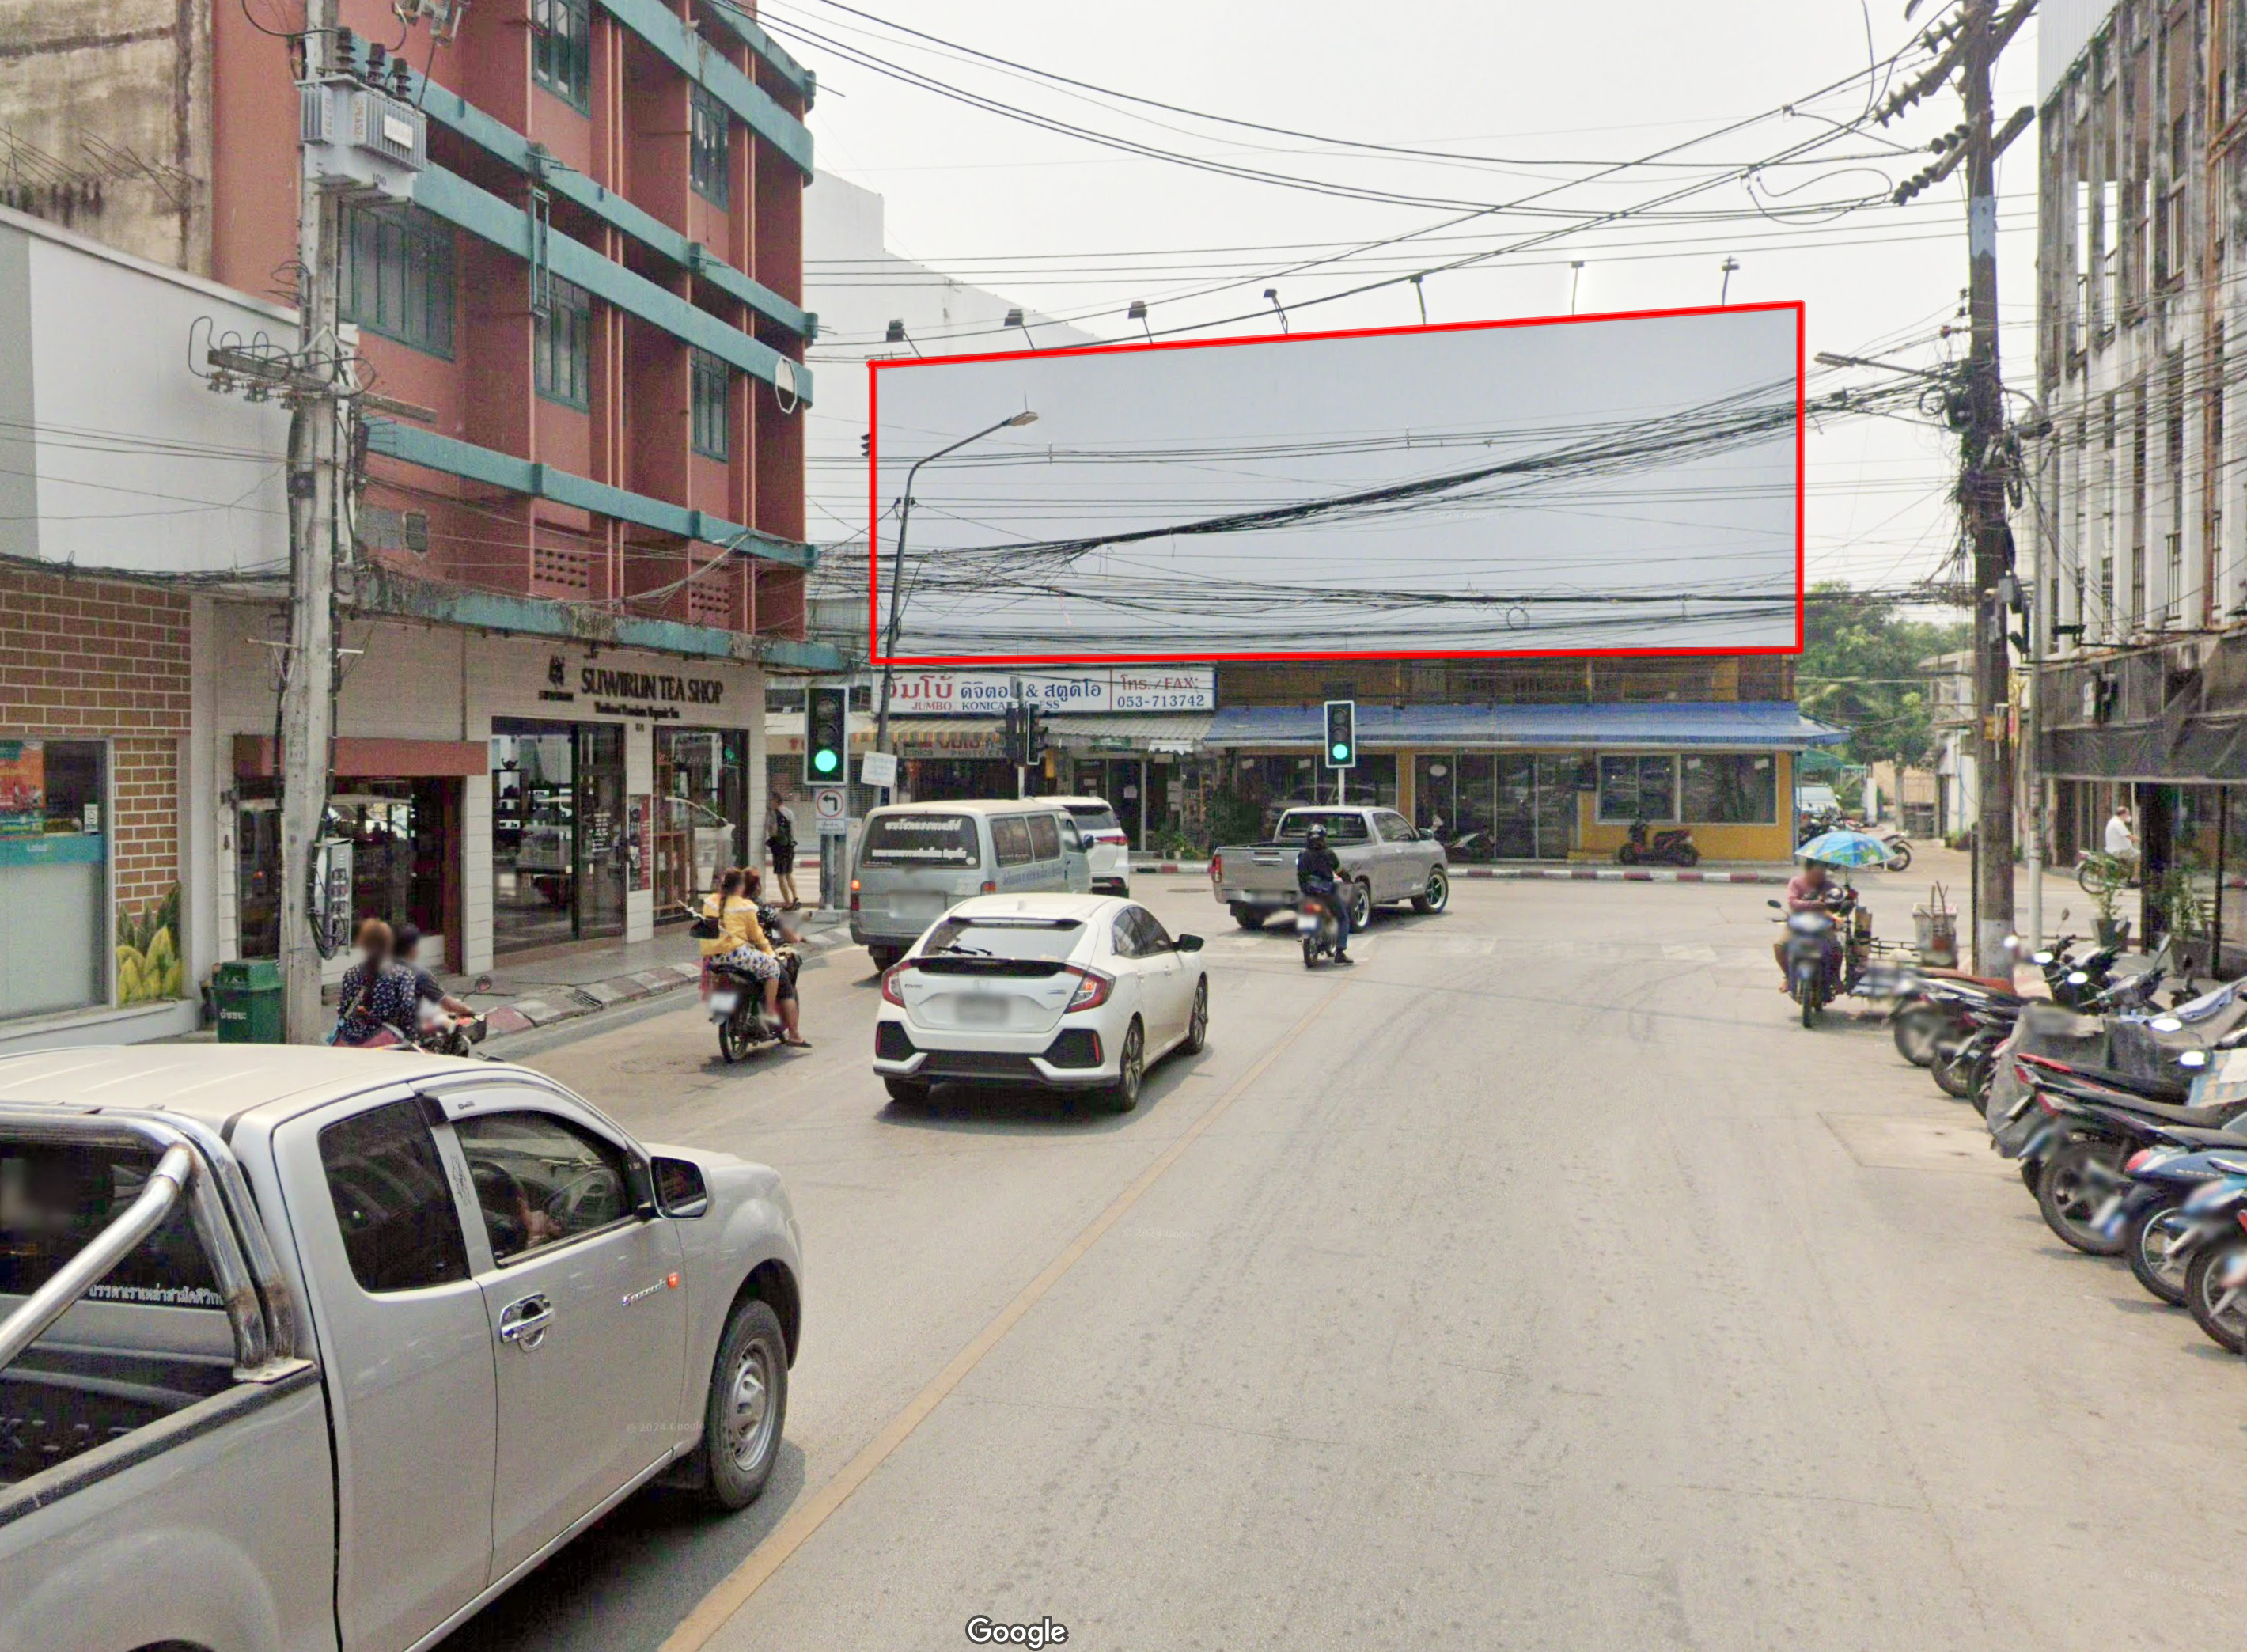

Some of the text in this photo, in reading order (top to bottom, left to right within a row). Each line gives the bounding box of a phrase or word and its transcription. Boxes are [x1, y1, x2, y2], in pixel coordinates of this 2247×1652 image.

[658, 676, 686, 702] TEA
[687, 679, 724, 705] SHOP
[961, 681, 1013, 699] ดิจิตอ
[1026, 684, 1038, 698] &
[1044, 678, 1101, 703] สตูดิโอ
[911, 701, 953, 711] JUMBO
[962, 701, 1006, 711] KONICA
[1117, 694, 1205, 708] 053-713742
